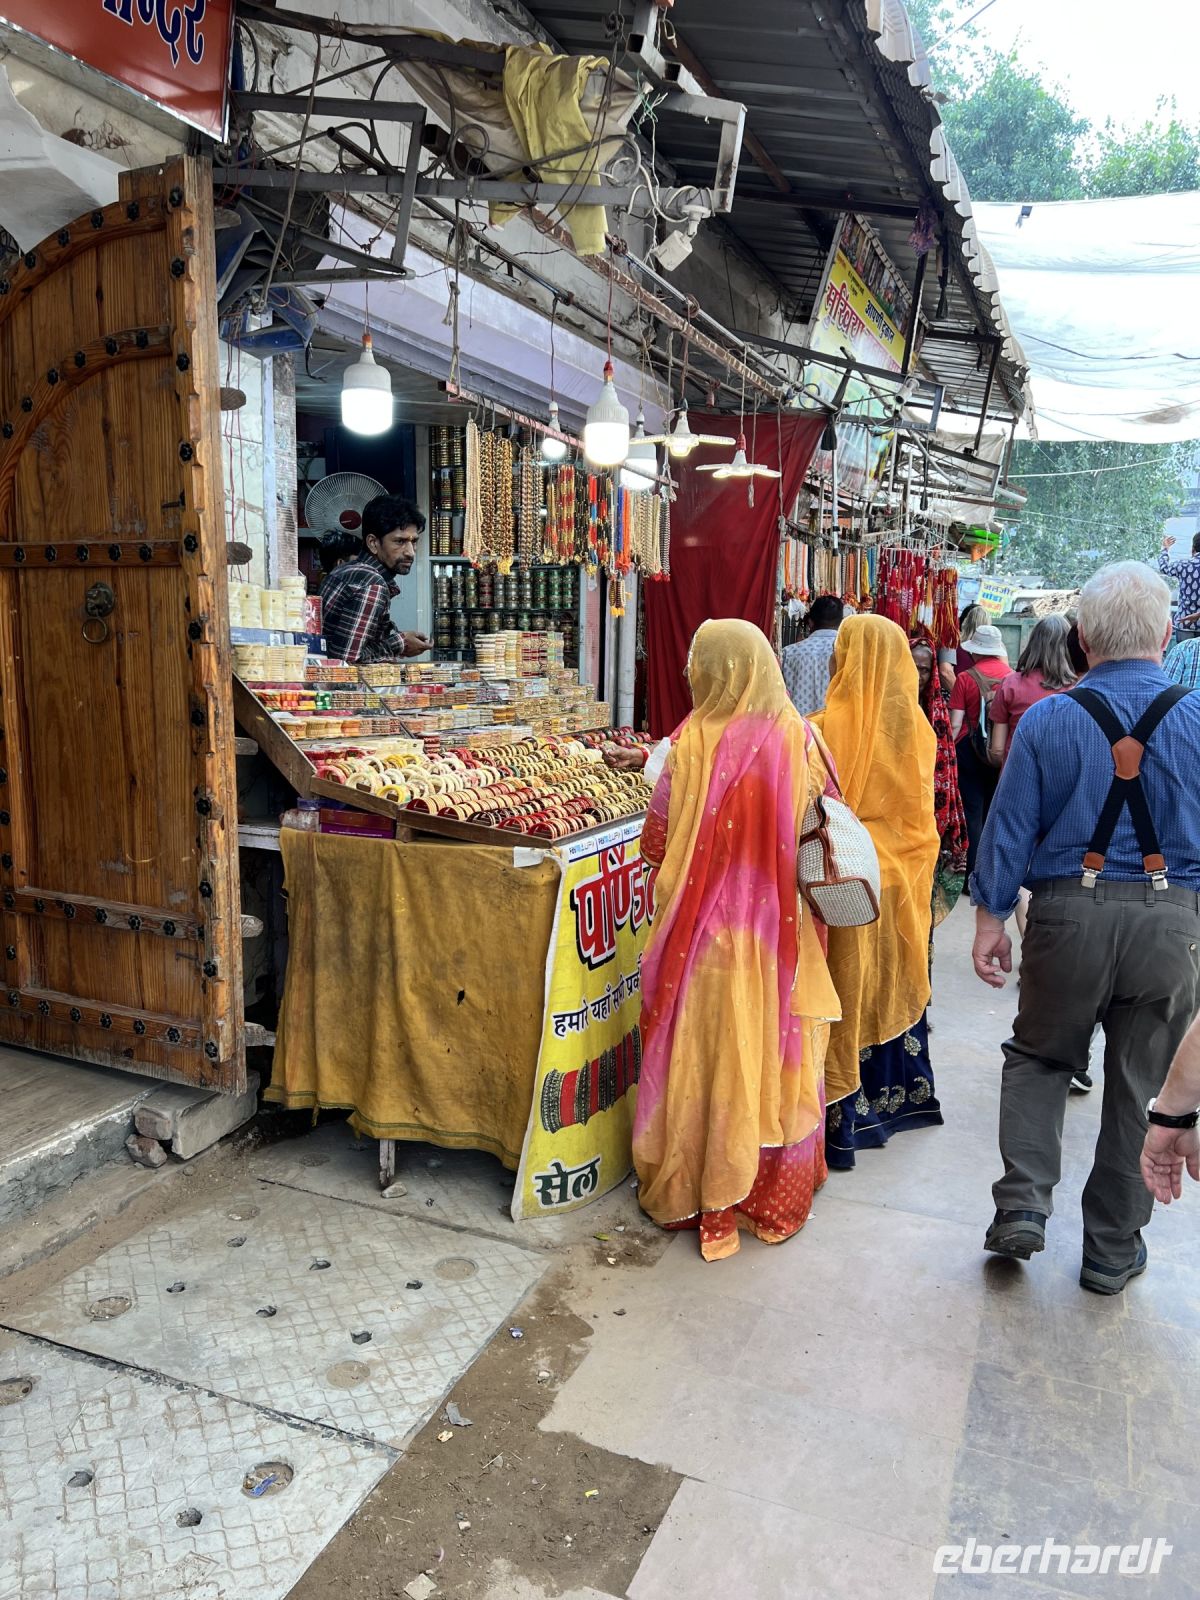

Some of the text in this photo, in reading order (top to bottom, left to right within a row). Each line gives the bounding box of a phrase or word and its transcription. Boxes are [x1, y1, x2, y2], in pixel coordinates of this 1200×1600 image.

[552, 1001, 588, 1037] हमारे
[591, 984, 611, 1020] यहाँ
[535, 1157, 601, 1206] सेल
